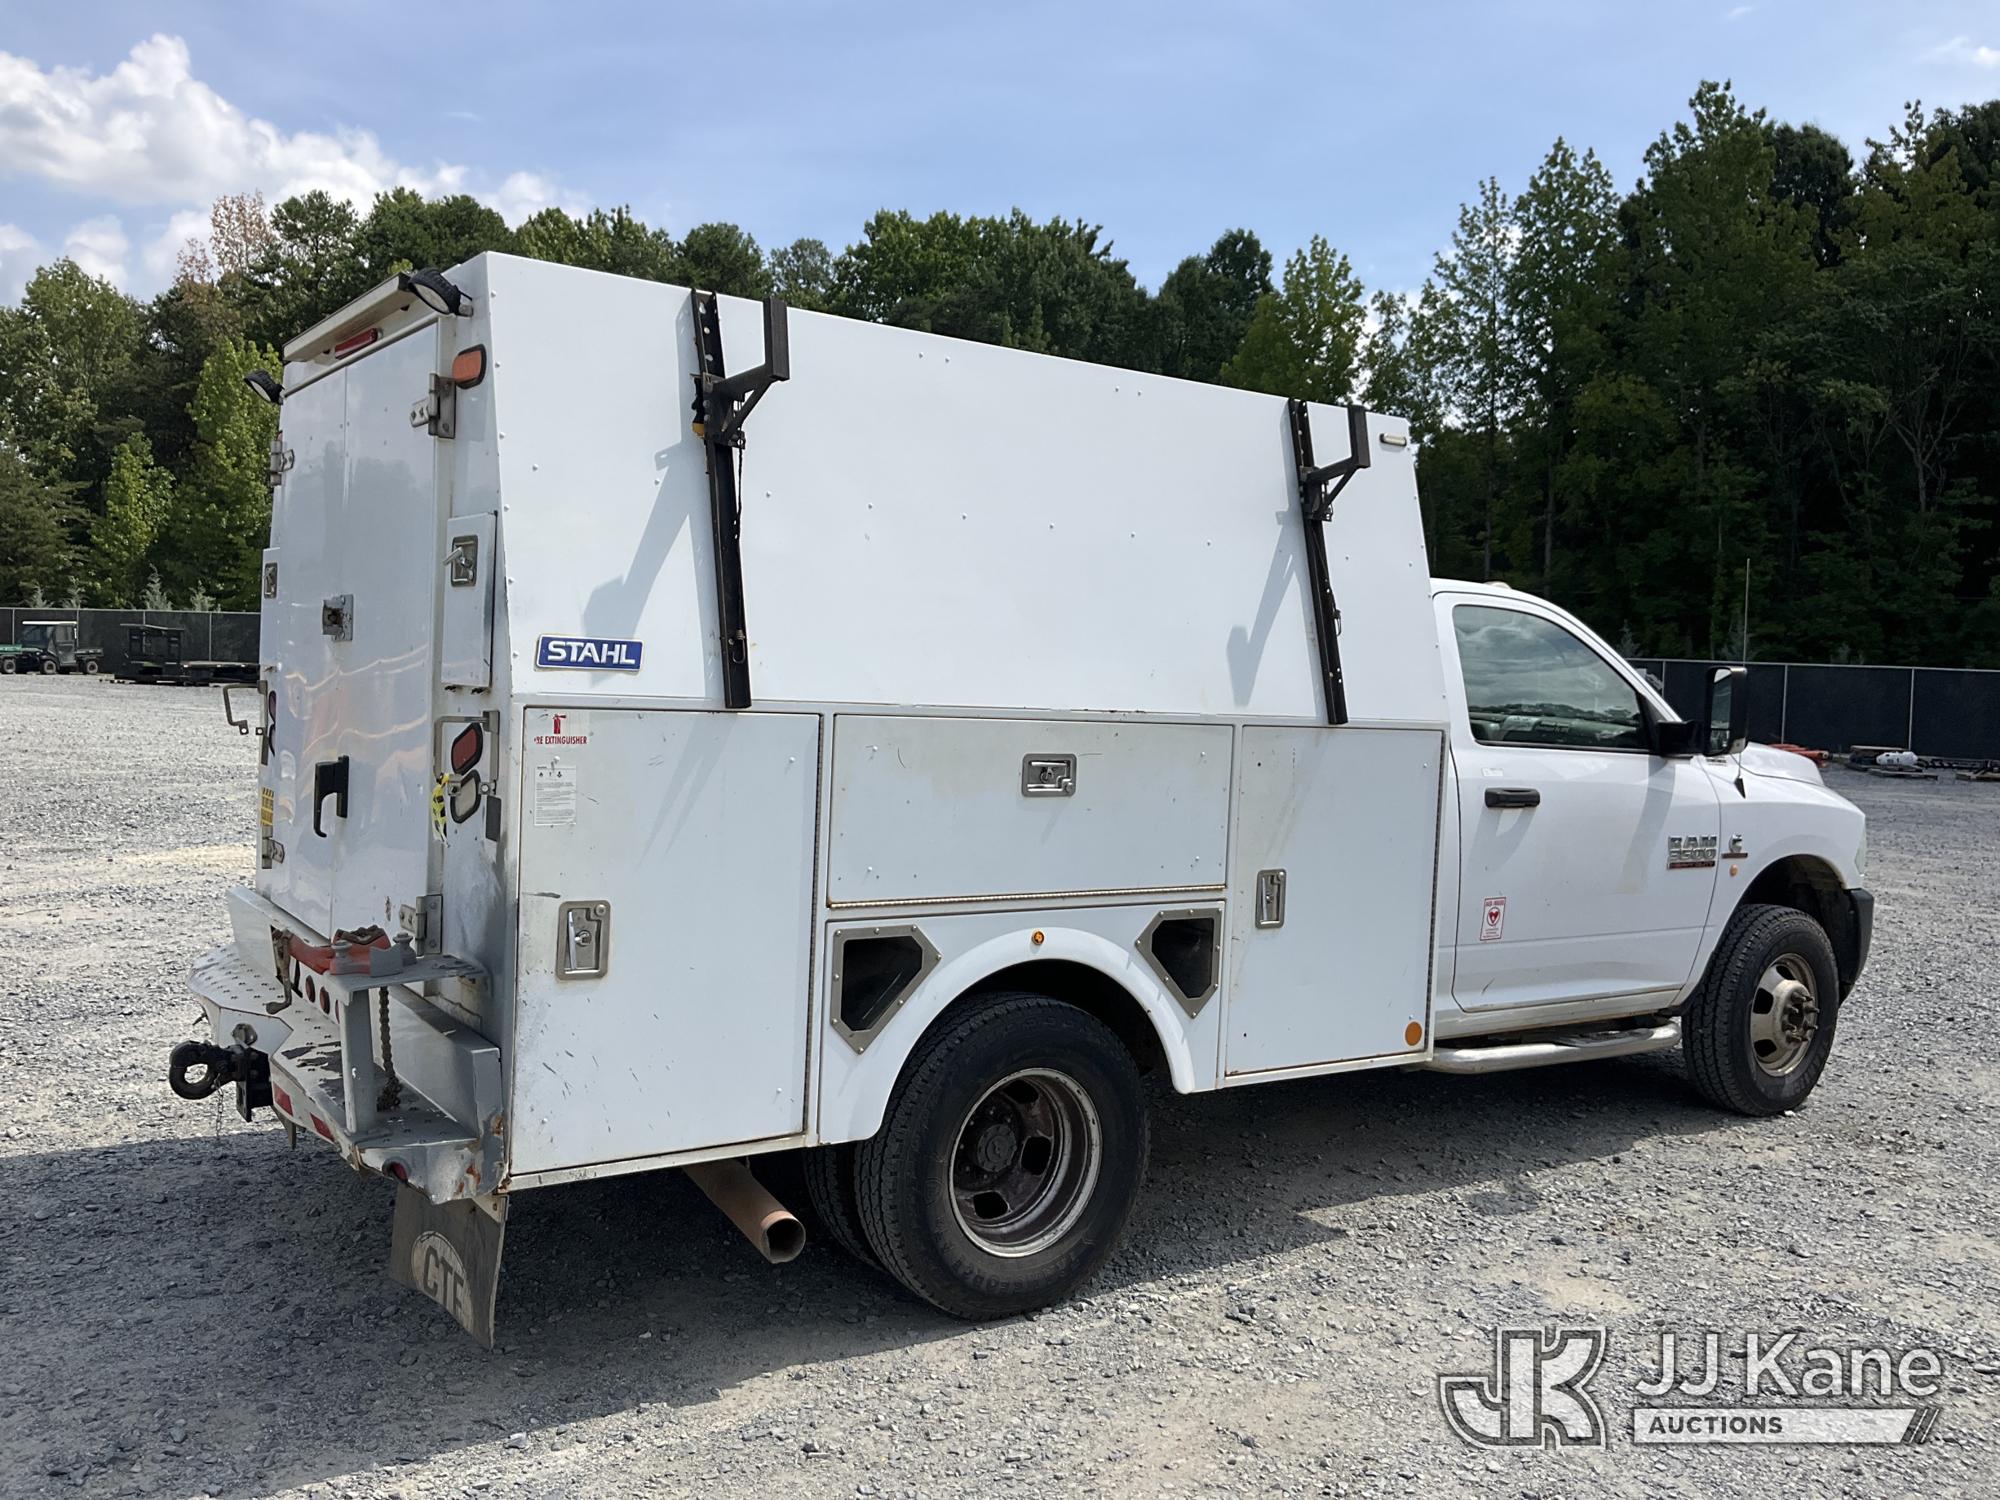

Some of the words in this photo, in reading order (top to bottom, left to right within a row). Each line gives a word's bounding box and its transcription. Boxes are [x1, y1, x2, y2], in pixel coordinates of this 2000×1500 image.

[547, 640, 636, 664] STAHL
[545, 735, 588, 745] EXTINGUISHER
[1668, 835, 1717, 848] RAM
